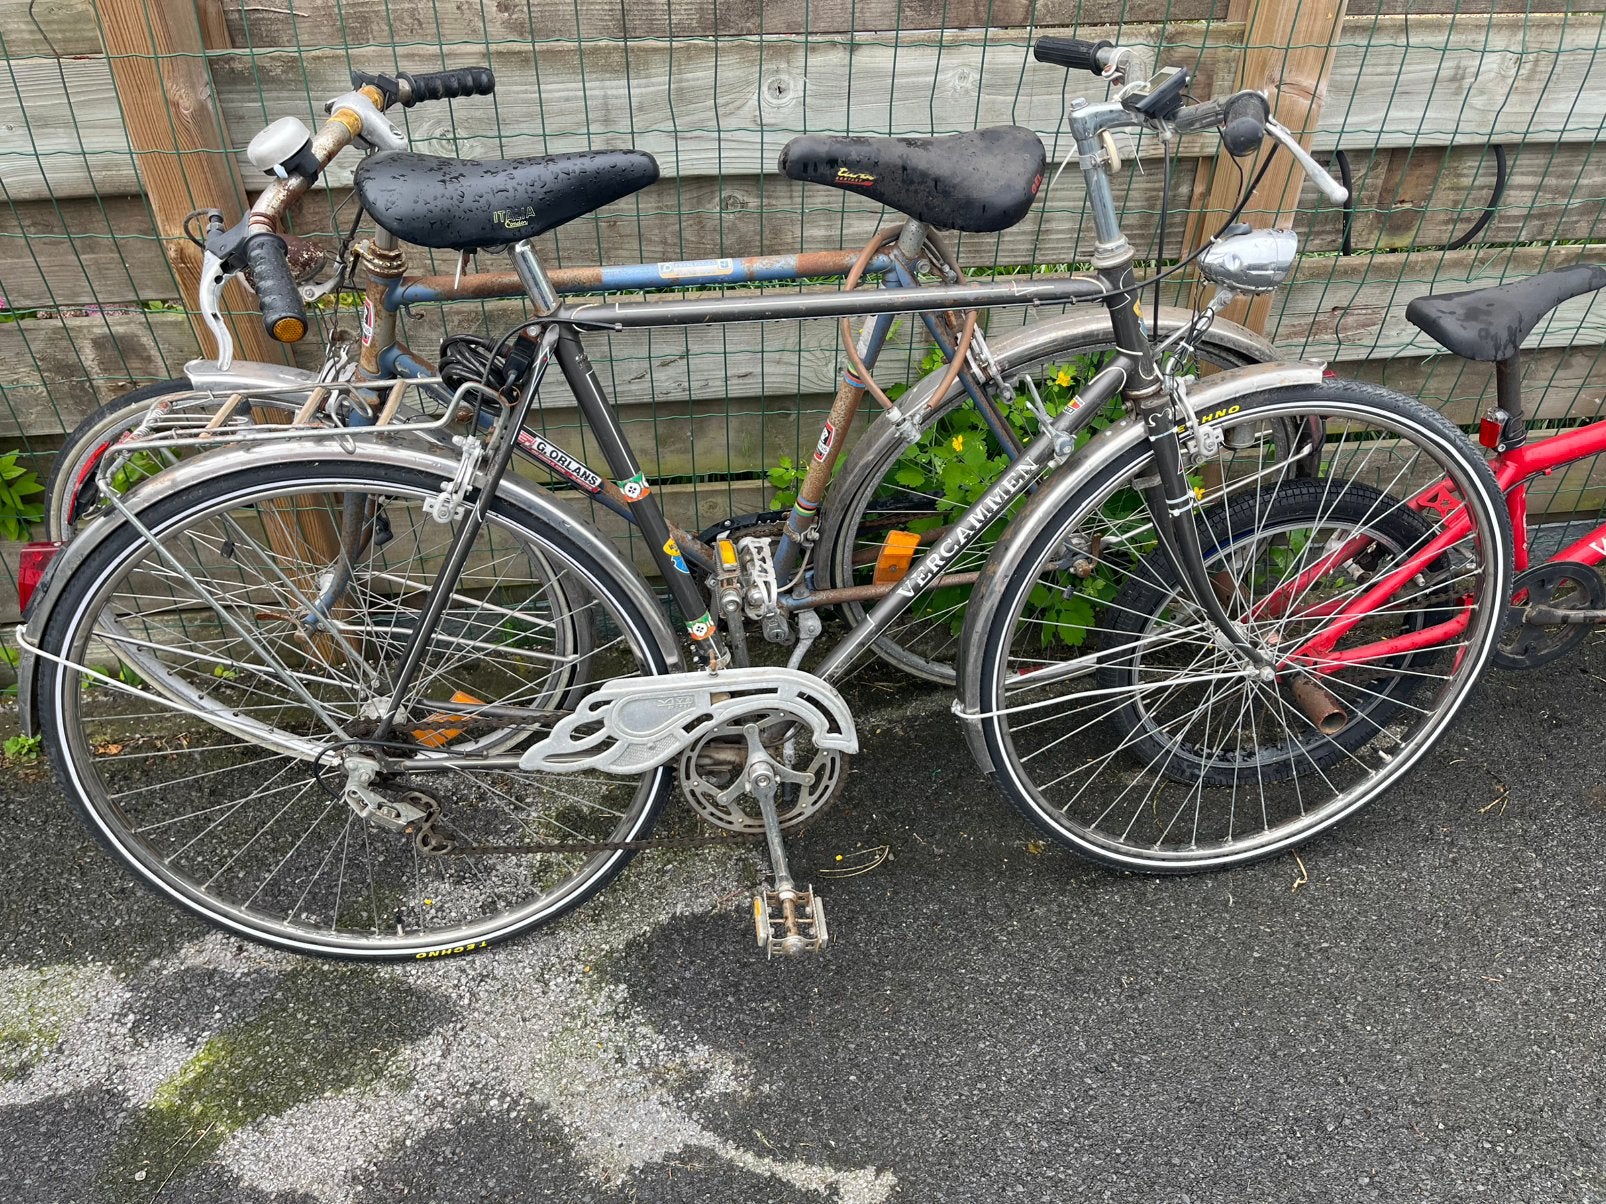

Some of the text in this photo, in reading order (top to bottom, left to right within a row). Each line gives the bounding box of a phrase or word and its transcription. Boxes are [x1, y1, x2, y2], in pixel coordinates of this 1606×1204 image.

[493, 206, 536, 223] ITALIA
[1177, 405, 1240, 434] EHNO
[896, 455, 1040, 598] VERCAMMEN
[415, 940, 488, 960] TECHNO
